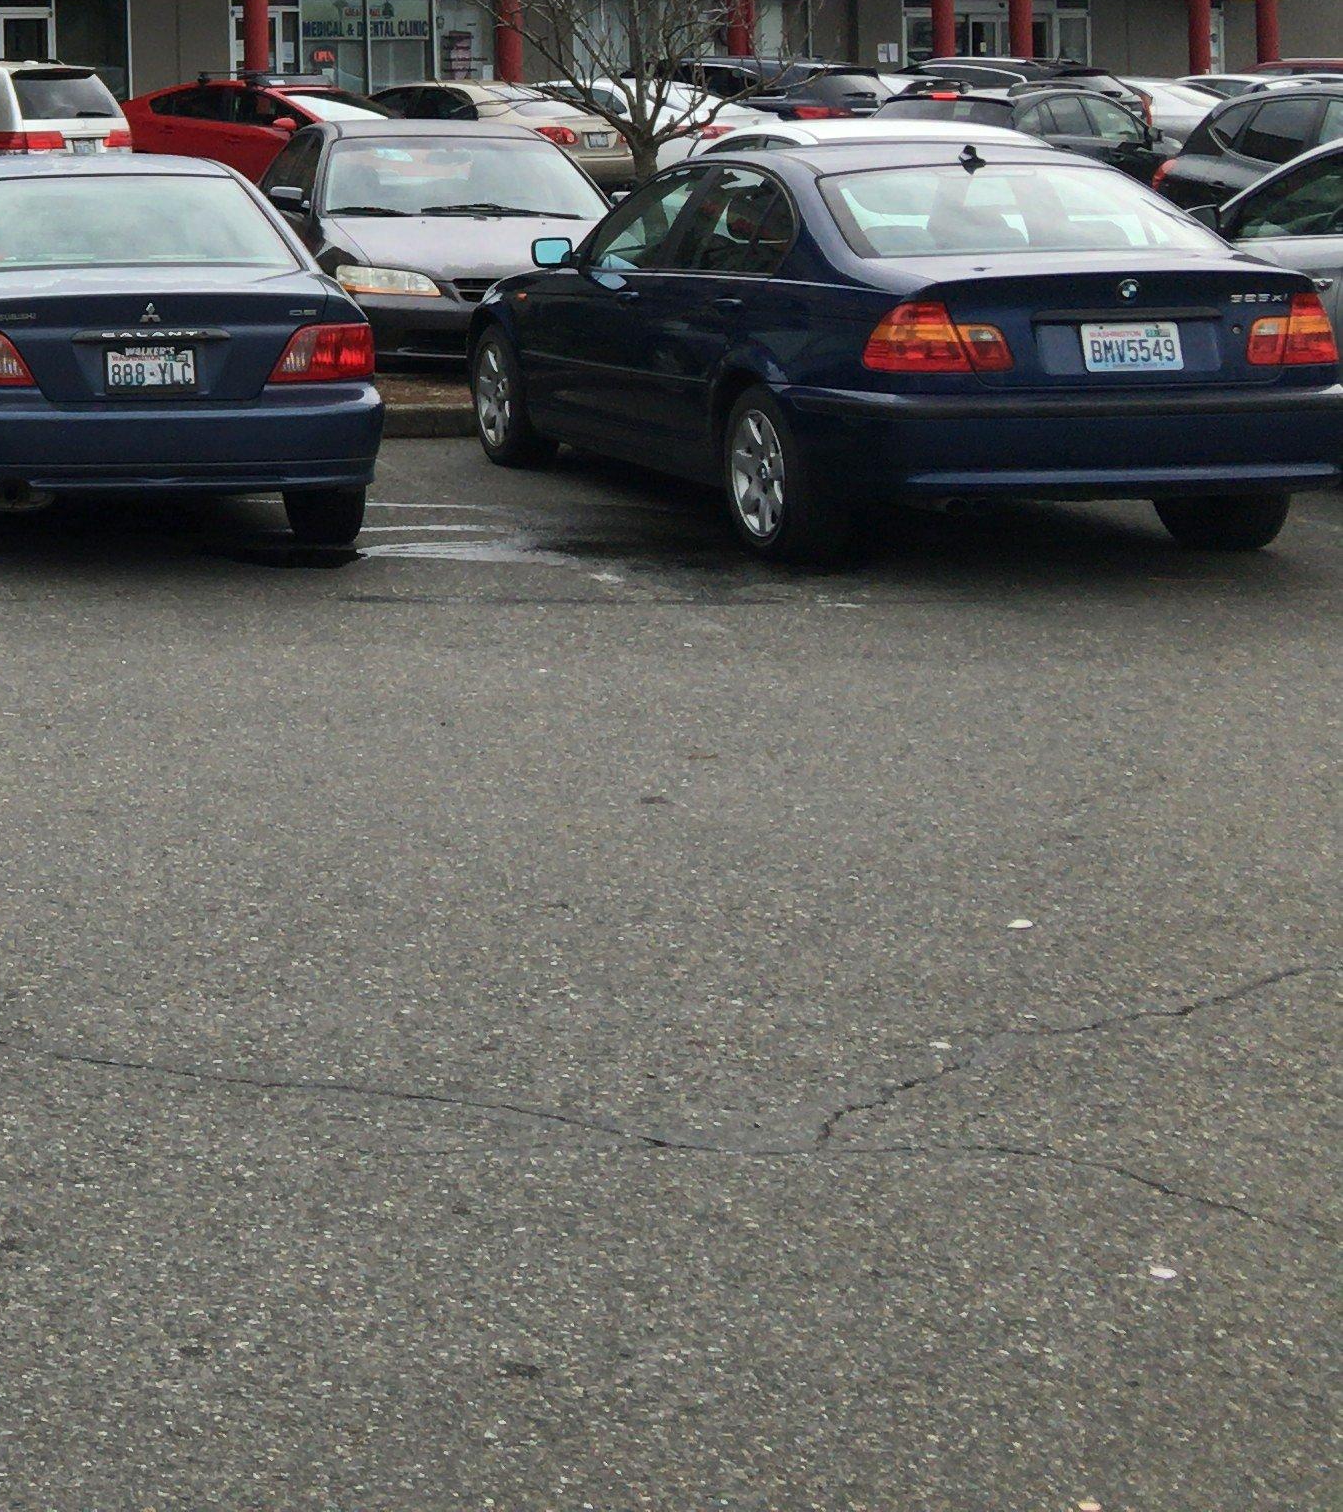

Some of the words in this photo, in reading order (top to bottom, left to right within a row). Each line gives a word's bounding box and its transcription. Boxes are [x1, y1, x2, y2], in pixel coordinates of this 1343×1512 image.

[303, 20, 344, 38] MEDICAL
[348, 24, 356, 37] &
[398, 19, 429, 37] CLINIC
[1089, 330, 1142, 339] WASHINGTON
[124, 346, 176, 357] WALKER'S
[1090, 338, 1176, 364] BMV5549
